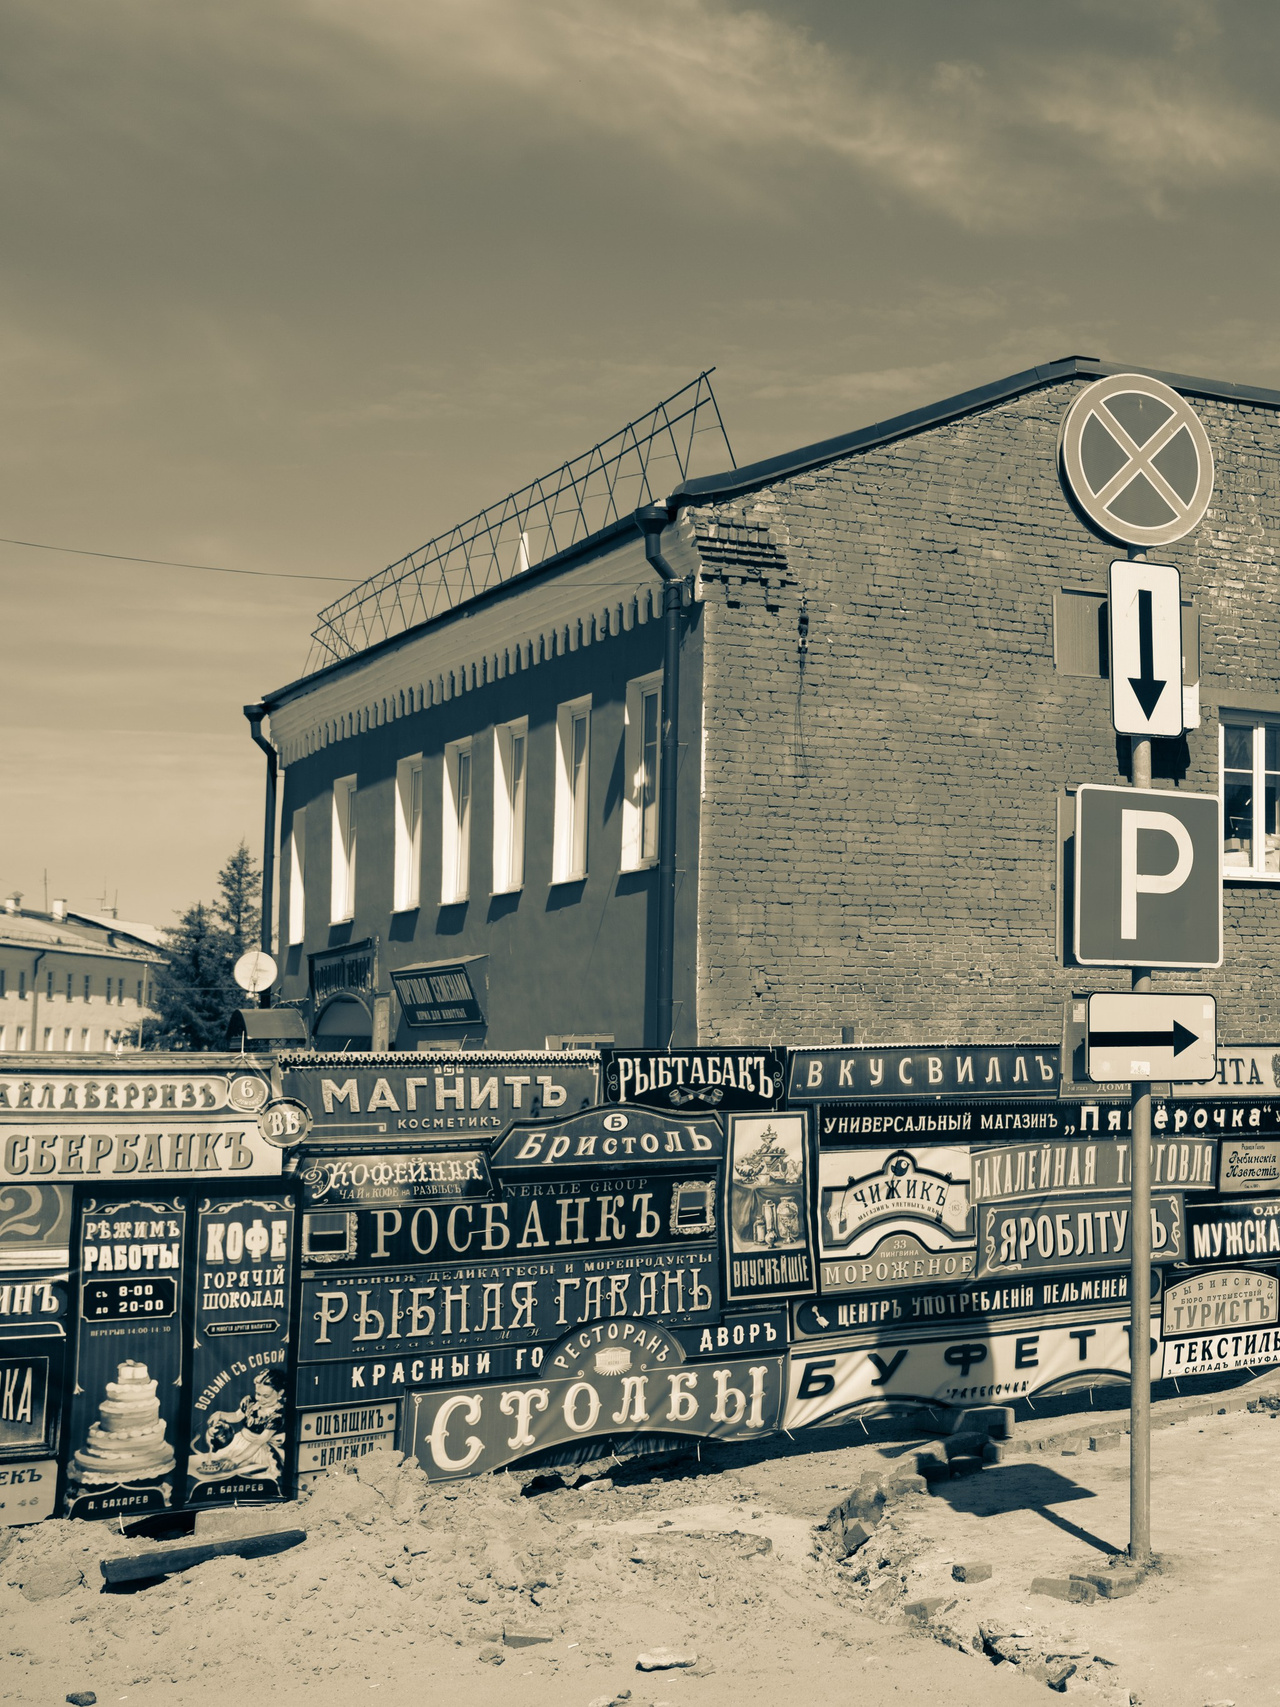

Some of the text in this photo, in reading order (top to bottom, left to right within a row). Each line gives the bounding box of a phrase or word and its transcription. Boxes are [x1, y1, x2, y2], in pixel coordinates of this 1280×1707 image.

[1120, 810, 1194, 939] P
[240, 1080, 254, 1098] 6
[617, 1056, 774, 1101] РЫБТАБАКЪ
[320, 1075, 569, 1114] МАГНИТЪ
[268, 1110, 301, 1137] ВБ
[397, 1116, 502, 1130] КОСМЕТИКЪ
[610, 1116, 622, 1128] Б
[823, 1109, 972, 1135] УНИВЕРСАЛЬНЫЙ
[980, 1112, 1059, 1130] МАГАЗИНЪ
[1063, 1104, 1272, 1136] „Пяёрочка“
[4, 1131, 254, 1176] СБЕРБАНКЪ
[514, 1126, 713, 1164] Бристоль
[314, 1157, 484, 1196] КОФЕЙНАЯ
[974, 1143, 1213, 1197] БАКАЛЕЙНАЯ ТГОВЛЯ
[339, 1187, 365, 1199] ЧАЙ
[371, 1187, 399, 1198] КОФЕ
[590, 1178, 648, 1193] GROUP
[853, 1179, 946, 1208] ЧИЖИКЪ
[370, 1193, 661, 1258] РОСБАНКЪ
[857, 1203, 890, 1221] МАГАЗИНЪ
[85, 1219, 181, 1241] РѢЖИМЪ
[205, 1219, 288, 1265] КОФЕ
[1000, 1209, 1168, 1263] ЯРОБЛТУЪ
[83, 1243, 181, 1272] РАБОТЫ
[880, 1249, 919, 1258] ПИНГВИНА
[893, 1240, 907, 1250] 33
[203, 1264, 286, 1289] ГОРЯЧІЙ
[427, 1264, 554, 1283] ДЕЛИКАТЕСЫ
[564, 1262, 574, 1274] И
[584, 1253, 712, 1272] МОРЕПРОДУКТЫ
[733, 1253, 809, 1288] ВКУСНѢЙШІЕ
[824, 1254, 974, 1286] МОРОЖЕНОЕ
[118, 1284, 154, 1297] 8-00
[202, 1289, 285, 1310] ШОКОЛАД
[837, 1275, 1127, 1327] ЦЕНТРЪ УПОТРЕБЛЕНІЯ ПЕЛЬМЕНЕЙ
[1171, 1277, 1274, 1301] РЫБИНСКОЕ
[1181, 1295, 1204, 1305] БЮРО
[96, 1299, 164, 1315] до 20-00
[313, 1268, 712, 1345] РЫБНАЯ ГАВАНЬ
[351, 1350, 491, 1388] КРАСНЫЙ
[699, 1322, 777, 1352] ДВОРЪ
[554, 1322, 670, 1369] РЕСТОРАНЪ
[194, 1348, 286, 1411] ВОЗЬМИ СЪ СОБОЙ
[1184, 1361, 1229, 1374] СКЛАДЪ
[315, 1408, 384, 1436] ОЦѢНЩИКЪ
[425, 1365, 768, 1471] СТОЛБЫ
[307, 1433, 387, 1449] АГЕНТСТВО НЕДВИЖИМОСТИ
[102, 1495, 149, 1509] БАХАРЕВ
[219, 1484, 264, 1494] БАХАРЕВ
